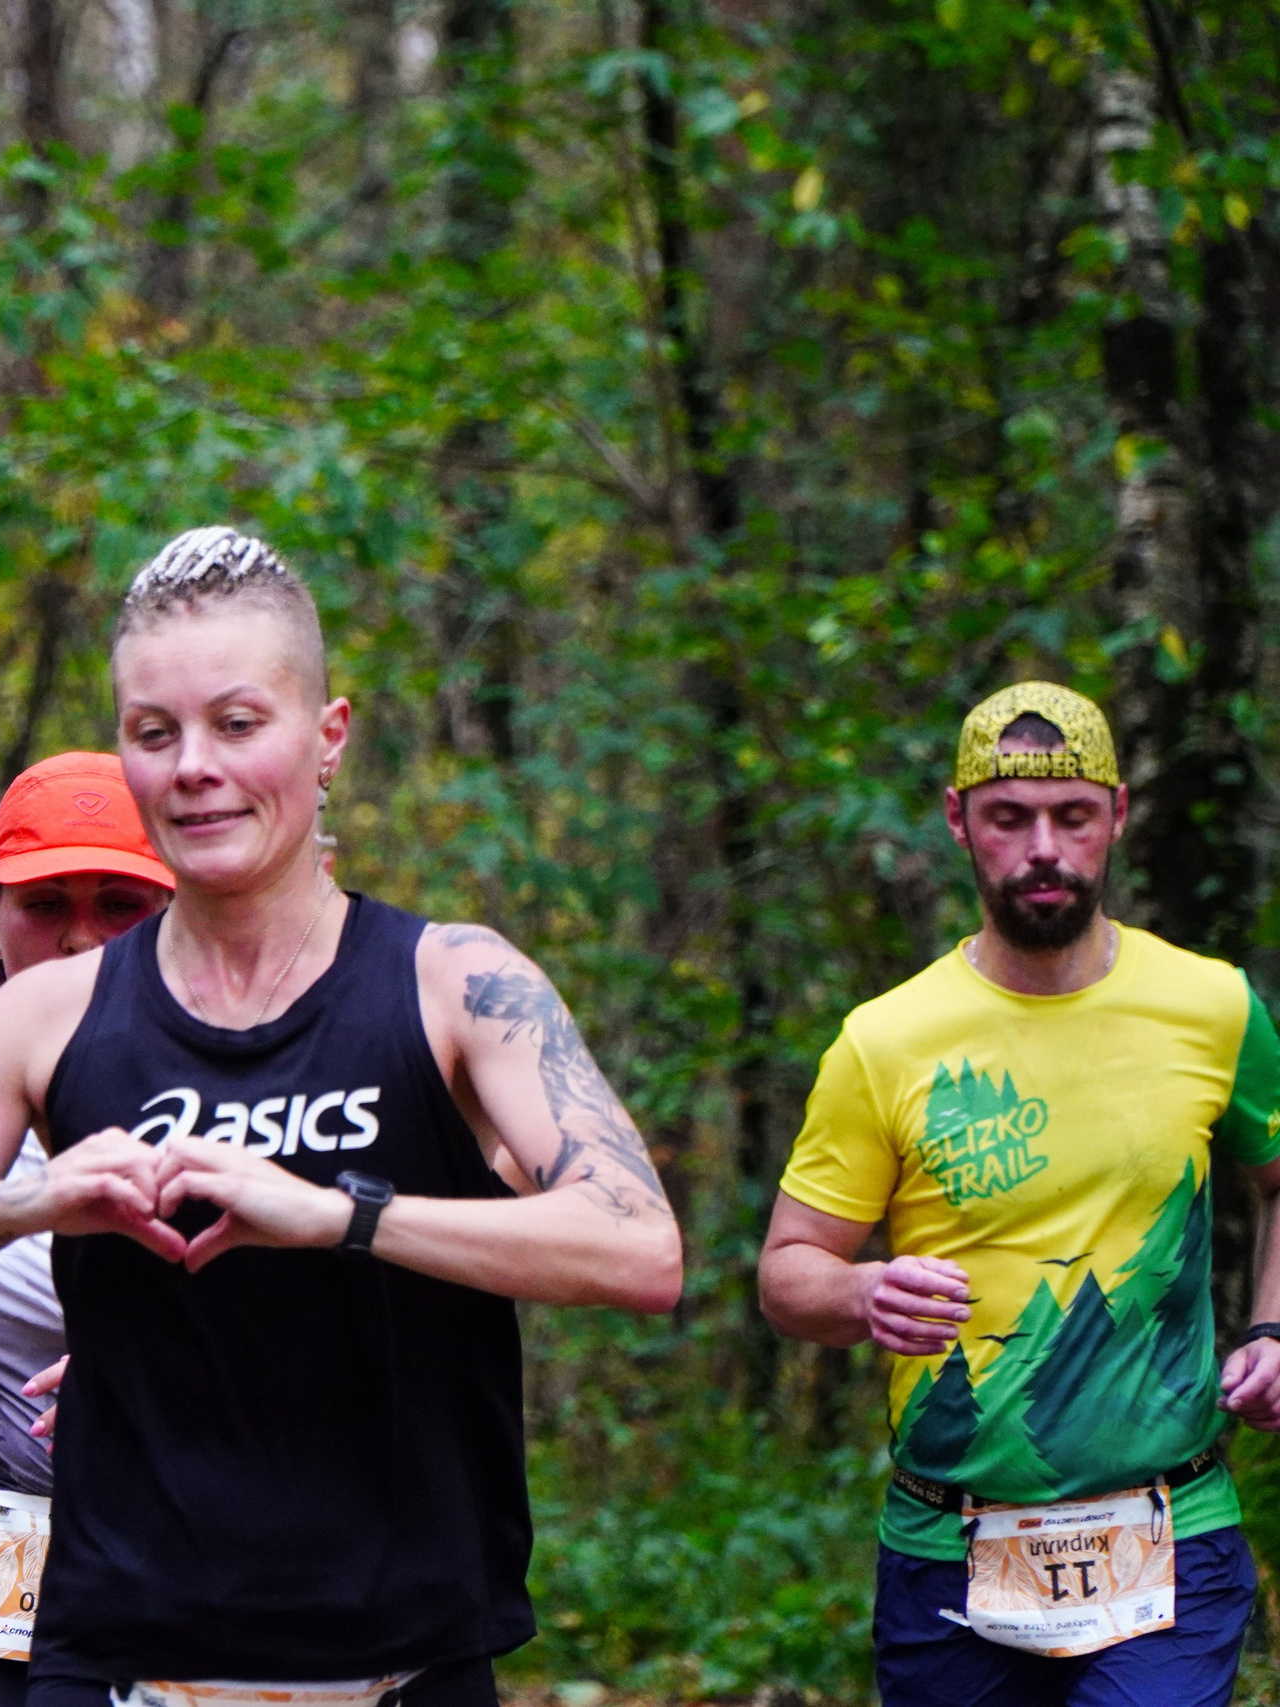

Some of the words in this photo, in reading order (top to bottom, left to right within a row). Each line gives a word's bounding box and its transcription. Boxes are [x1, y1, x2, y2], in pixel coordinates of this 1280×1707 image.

[941, 1148, 1046, 1202] TRAIL
[1029, 1534, 1109, 1557] Кирилл
[1044, 1561, 1098, 1602] 11
